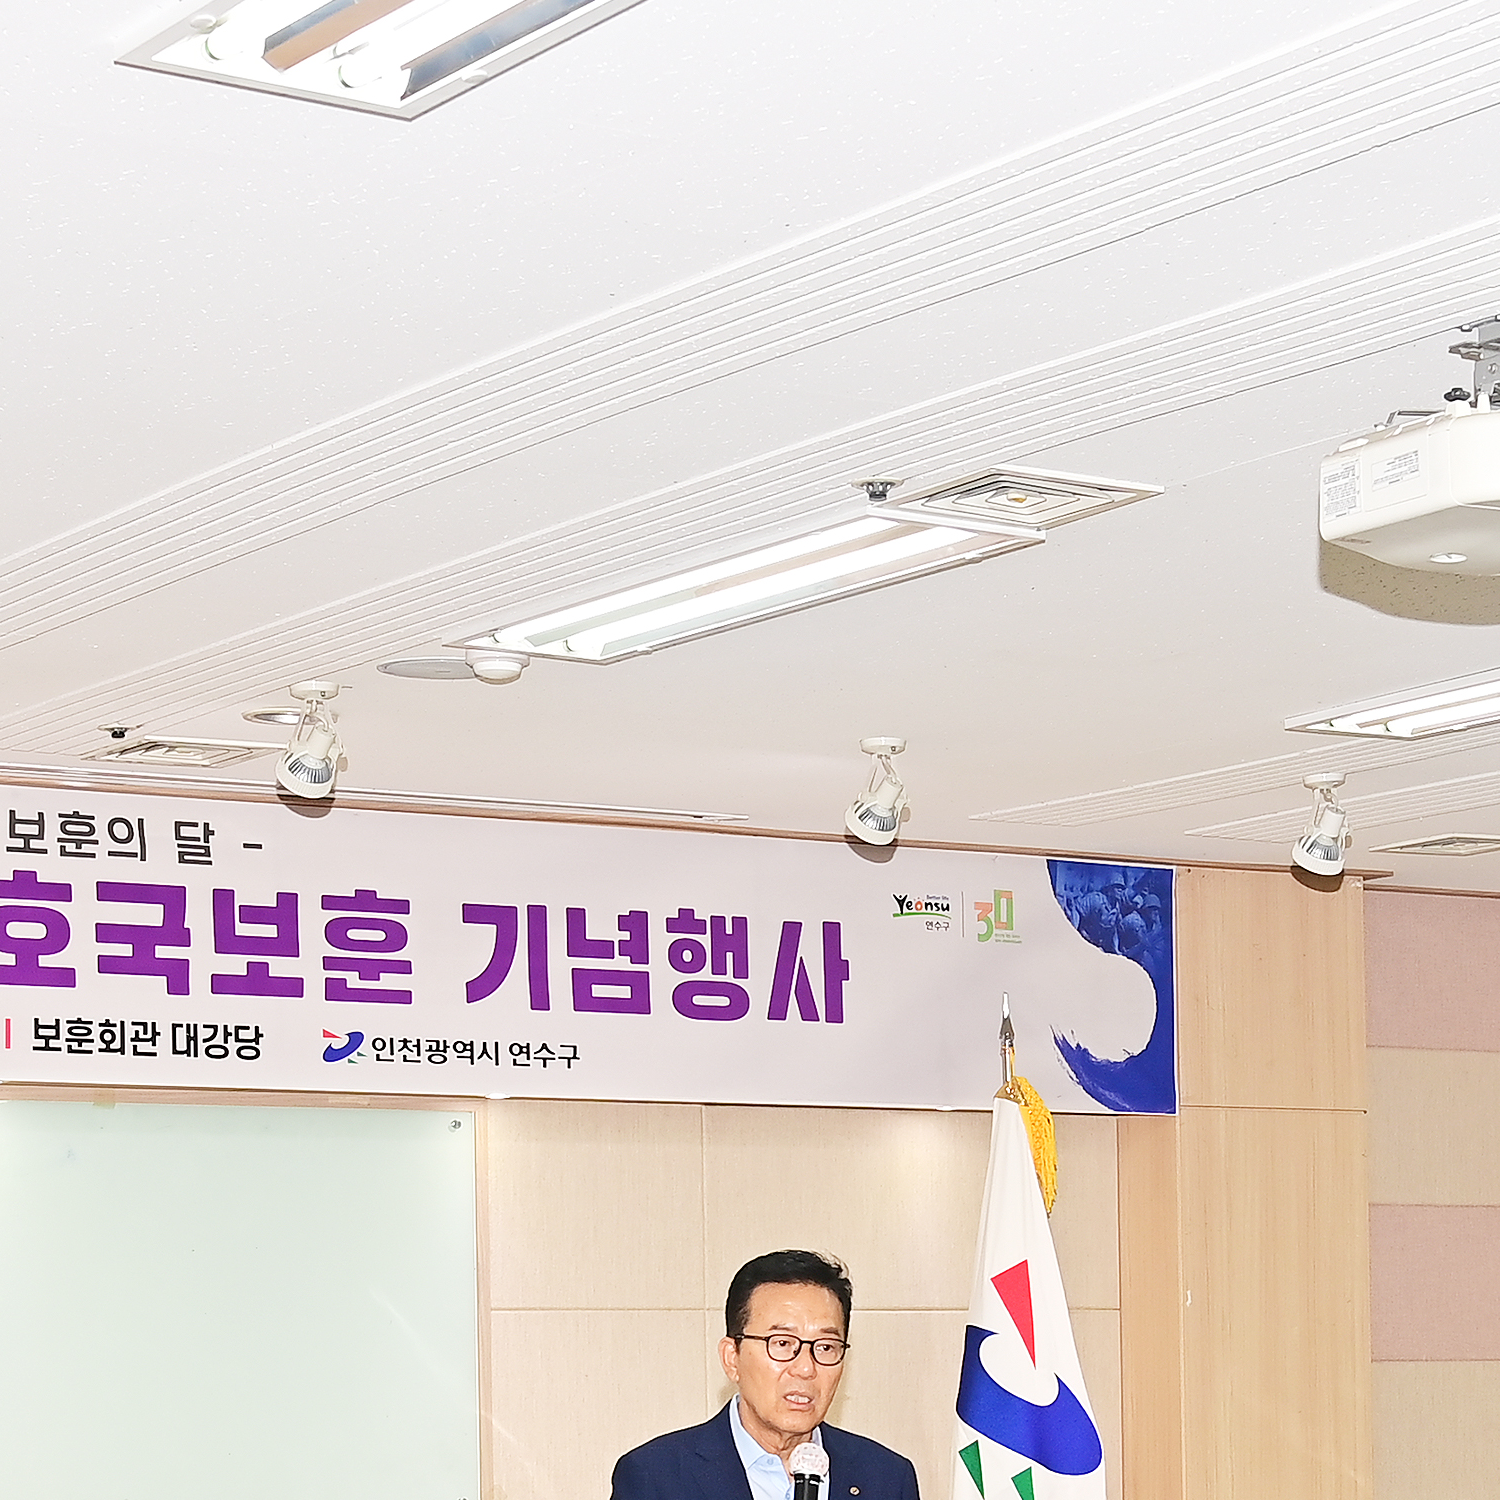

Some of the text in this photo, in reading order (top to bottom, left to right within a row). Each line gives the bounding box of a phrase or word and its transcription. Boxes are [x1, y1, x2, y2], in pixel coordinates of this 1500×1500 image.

[174, 820, 215, 866] 달
[893, 893, 950, 914] Yeonsu
[925, 920, 950, 932] 연수구
[461, 903, 850, 1024] 기념행사
[32, 1017, 162, 1058] 보훈회관
[170, 1022, 264, 1061] 대강당
[371, 1036, 581, 1070] 인천광역시 연수구
